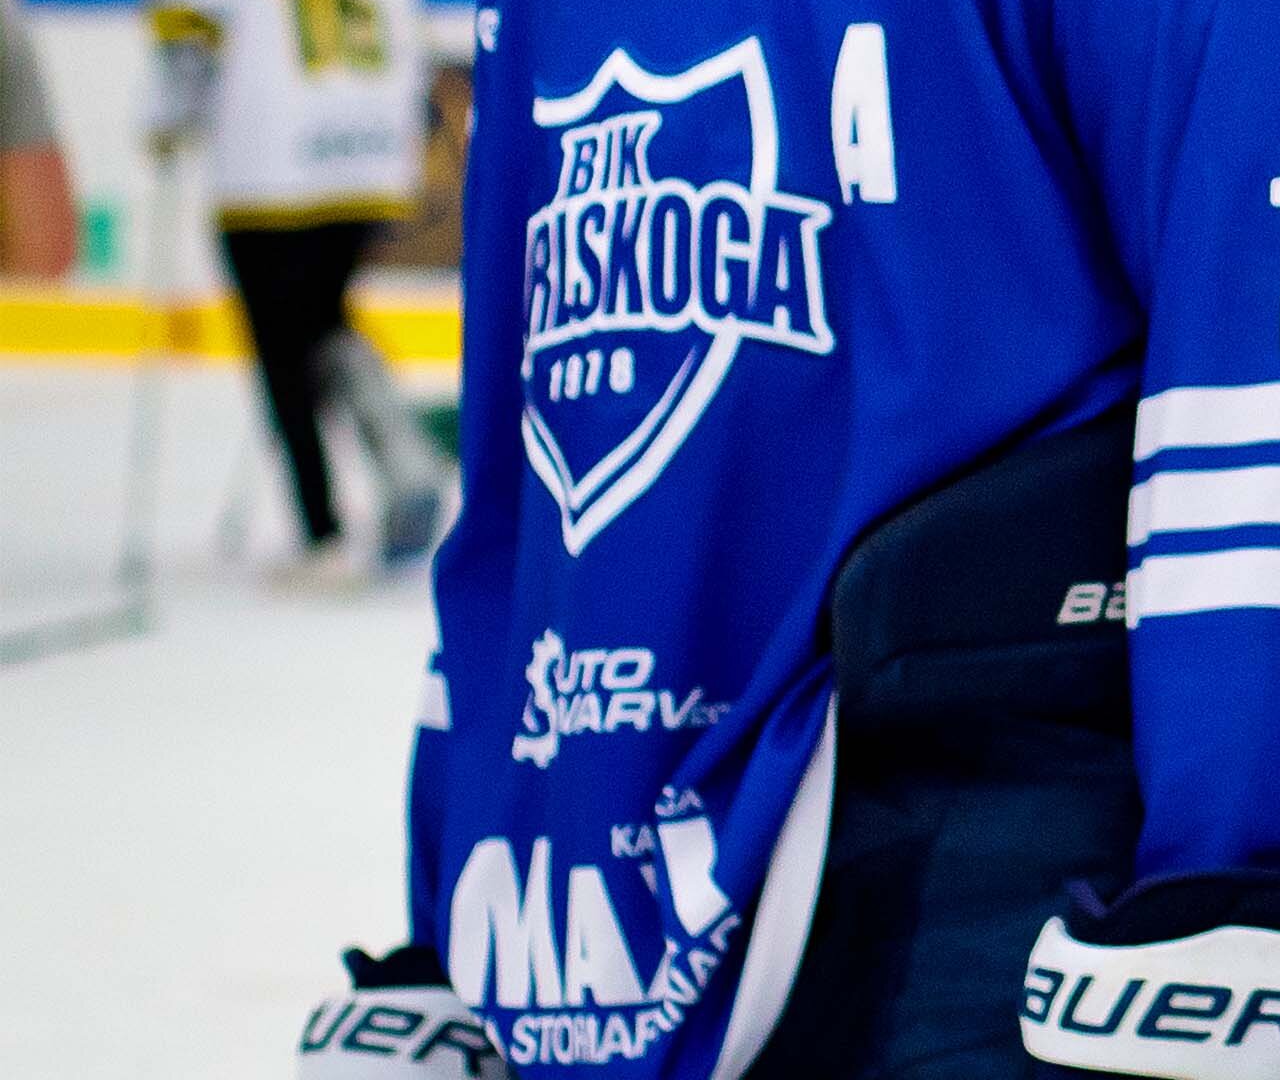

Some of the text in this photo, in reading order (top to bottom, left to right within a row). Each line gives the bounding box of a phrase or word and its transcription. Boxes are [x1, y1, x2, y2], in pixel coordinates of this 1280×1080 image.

[563, 116, 656, 198] BIK
[831, 22, 898, 206] A
[528, 190, 818, 335] RLSKOGA
[298, 1000, 498, 1079] UER
